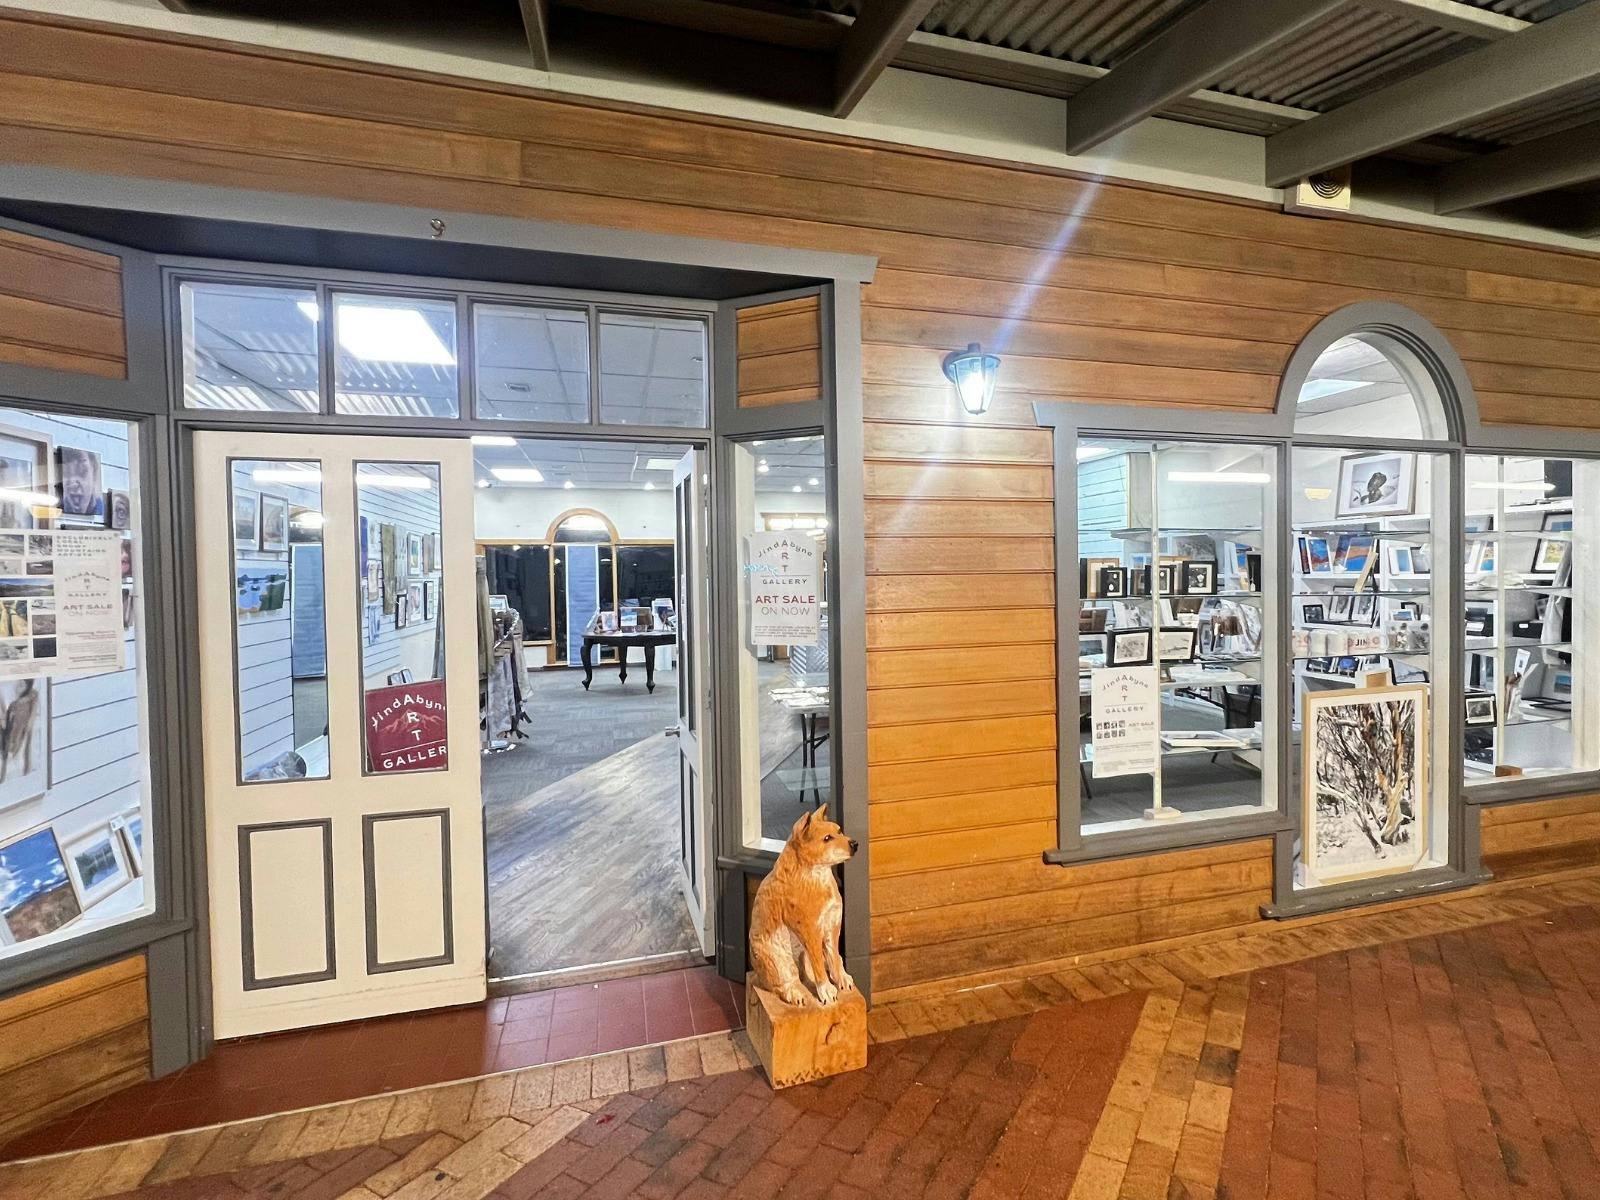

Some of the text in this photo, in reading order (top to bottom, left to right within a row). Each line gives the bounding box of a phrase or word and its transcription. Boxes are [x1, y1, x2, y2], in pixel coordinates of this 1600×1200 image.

[430, 218, 446, 239] 9
[755, 595, 816, 604] ART SALE
[761, 606, 811, 616] ON NOW
[371, 694, 446, 734] JindAbyn
[1105, 706, 1144, 714] GALLERY
[383, 745, 447, 769] GALLER
